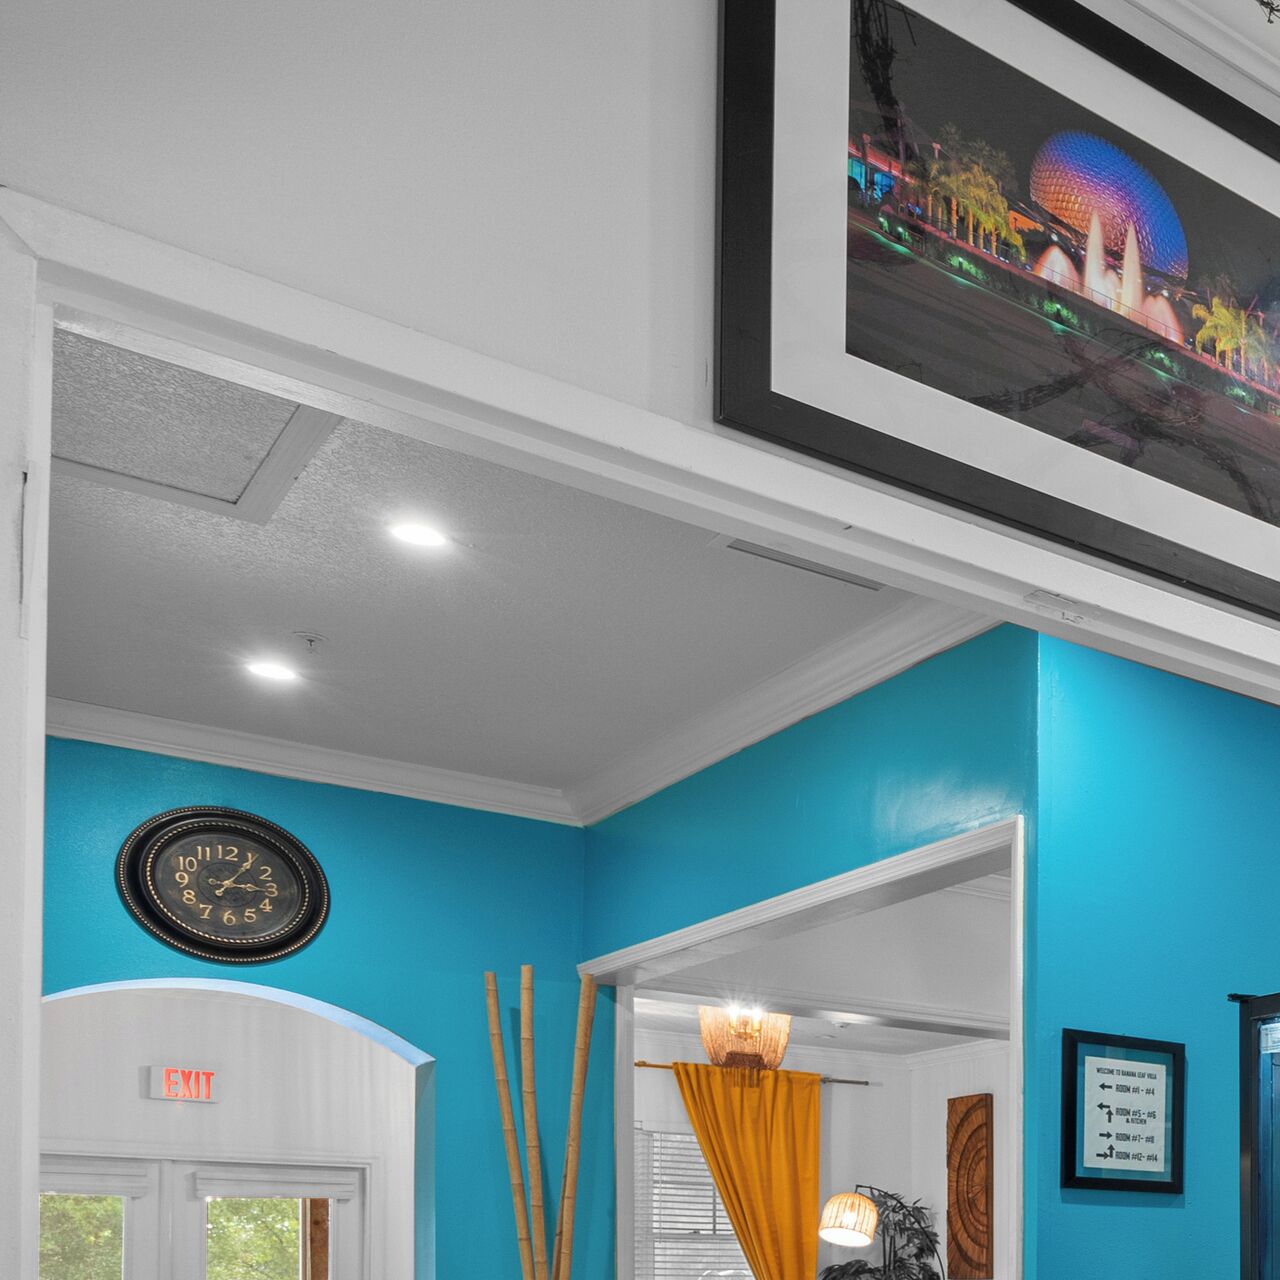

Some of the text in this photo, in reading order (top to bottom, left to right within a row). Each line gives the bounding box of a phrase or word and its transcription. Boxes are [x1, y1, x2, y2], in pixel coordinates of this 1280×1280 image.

[197, 846, 210, 860] 11
[216, 845, 238, 860] 12
[178, 856, 197, 872] 10
[175, 872, 189, 887] 9
[259, 866, 272, 880] 2
[182, 889, 196, 904] 8
[264, 883, 278, 897] 3
[199, 904, 213, 919] 7
[259, 898, 273, 912] 4
[223, 910, 236, 926] 6
[244, 908, 256, 922] 5
[163, 1067, 215, 1100] EXIT
[1115, 1083, 1131, 1093] ROOM
[1145, 1088, 1155, 1096] #4
[1115, 1107, 1131, 1117] ROOM
[1115, 1132, 1131, 1142] ROOM
[1115, 1151, 1131, 1160] ROOM
